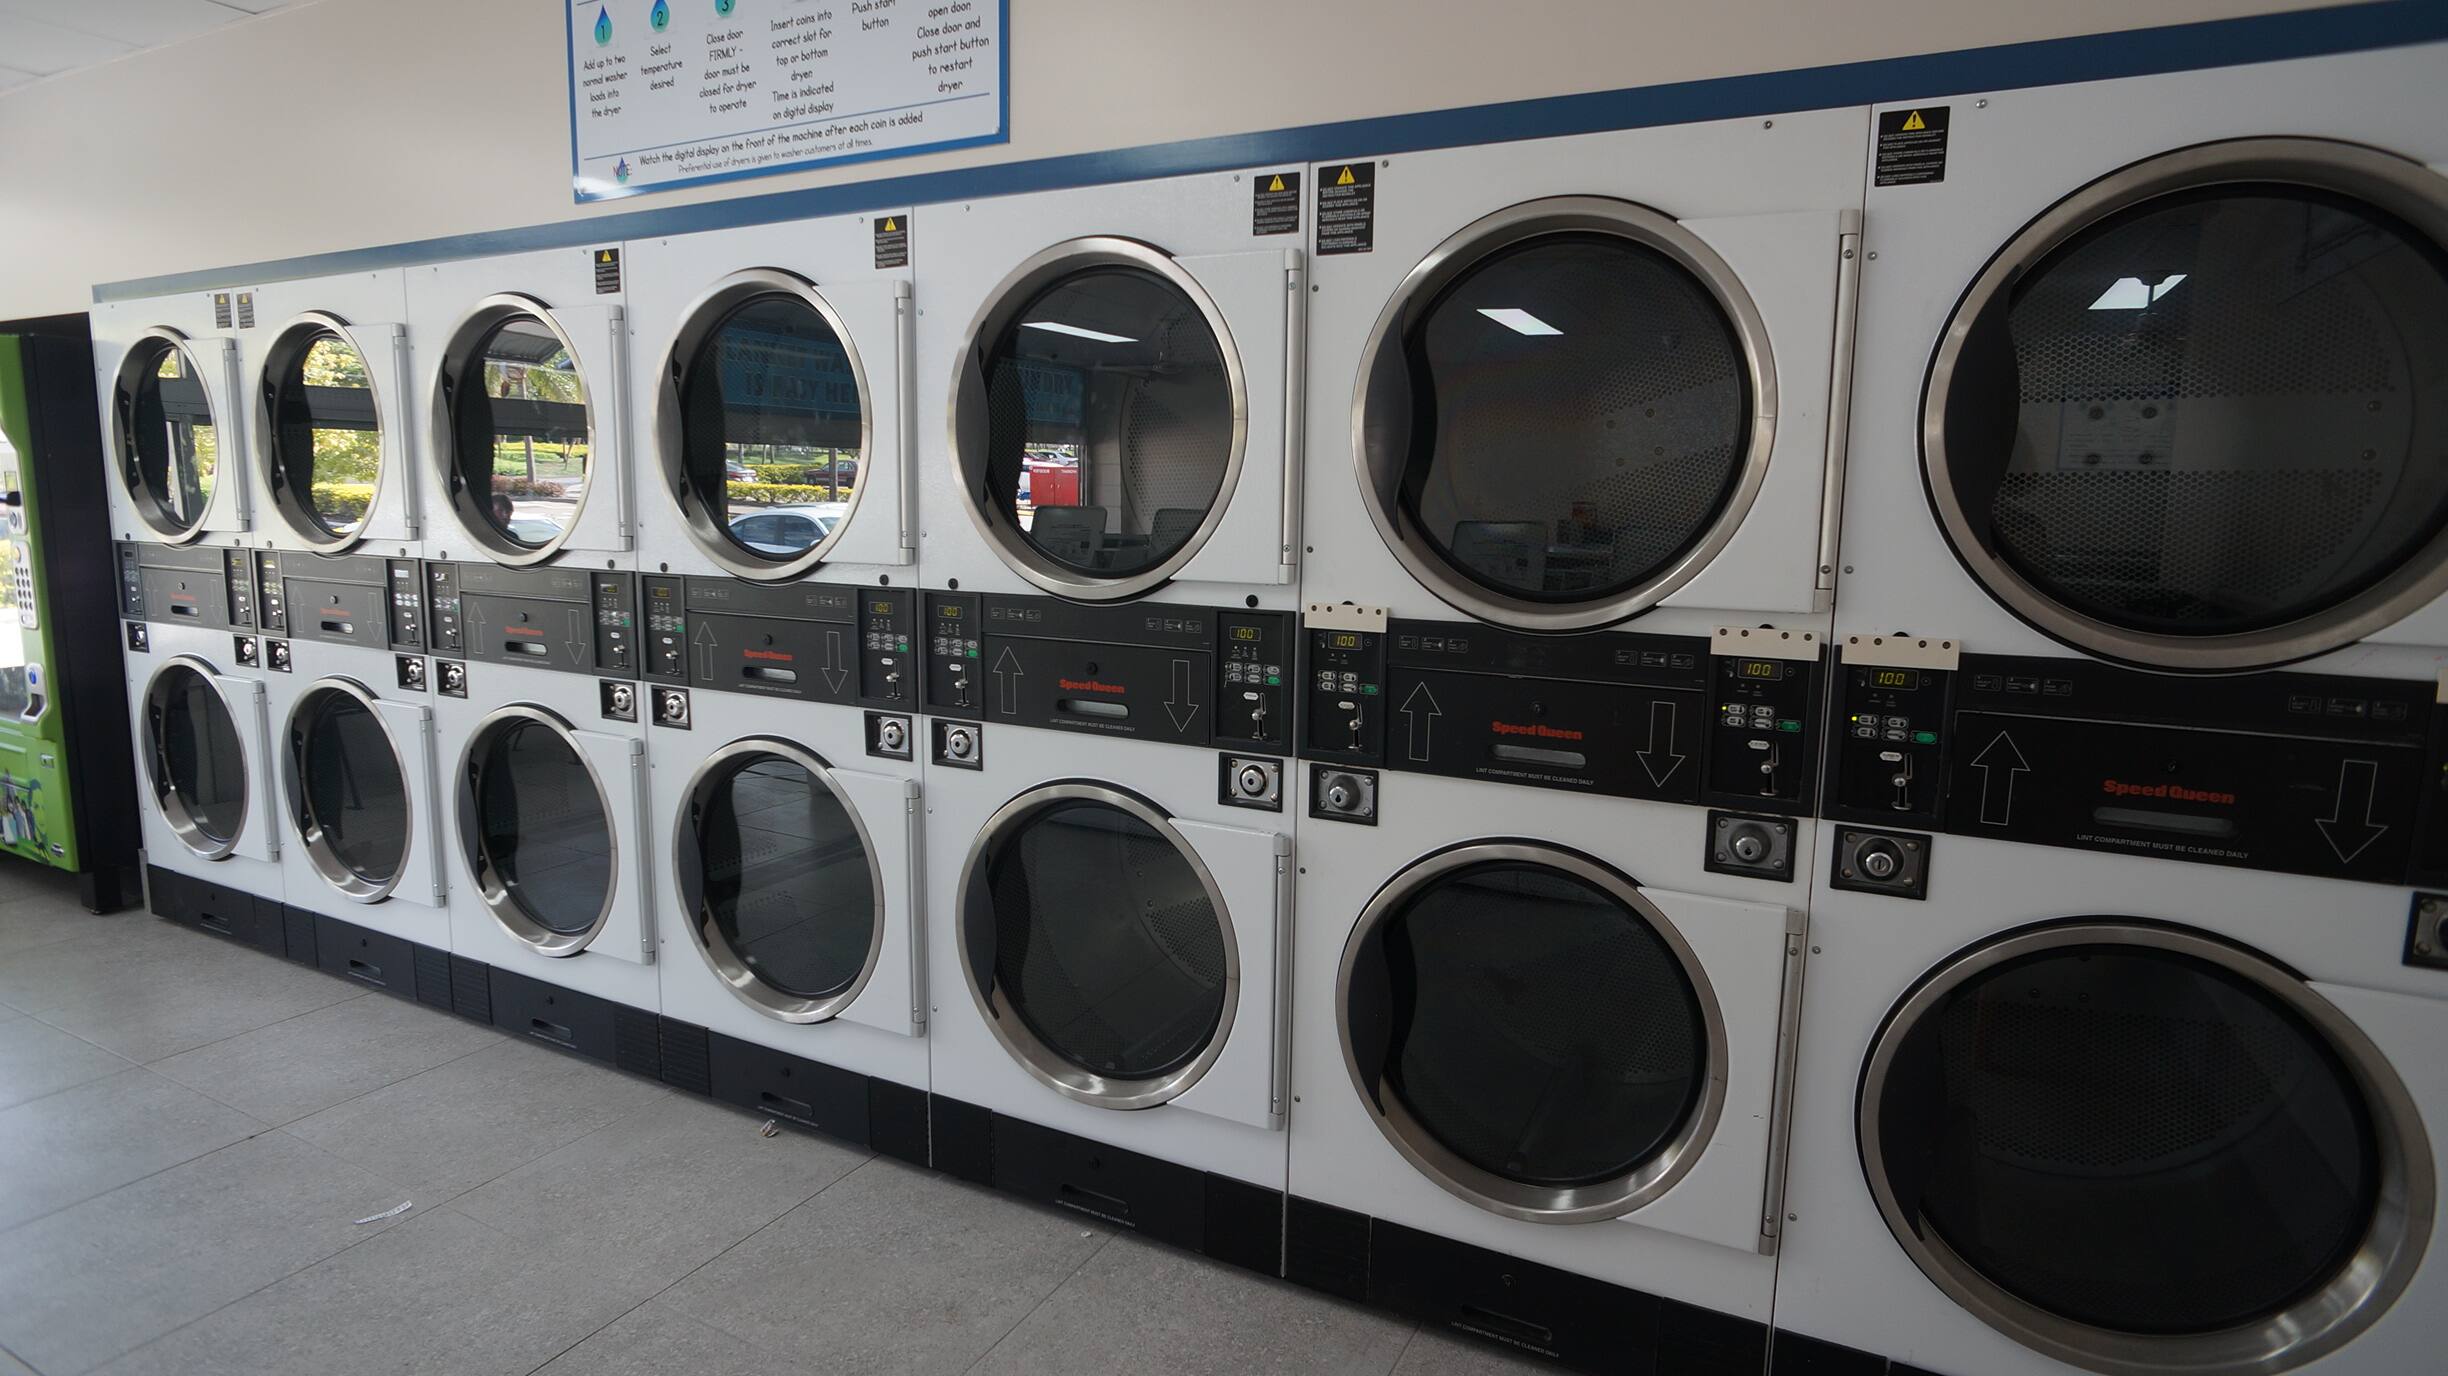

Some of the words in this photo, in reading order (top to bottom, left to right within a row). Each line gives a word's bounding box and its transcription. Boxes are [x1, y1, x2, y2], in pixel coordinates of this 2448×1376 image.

[721, 0, 729, 12] 3
[851, 0, 873, 14] Push
[874, 0, 896, 10] start
[928, 6, 949, 19] open
[657, 10, 664, 26] 2
[770, 16, 794, 32] Insert
[795, 13, 816, 26] coins
[817, 9, 832, 22] into
[861, 17, 890, 31] button
[600, 25, 605, 40] 1
[917, 26, 940, 39] Close
[942, 21, 963, 35] door
[965, 15, 981, 30] and
[706, 33, 725, 45] Close
[726, 28, 744, 41] door
[771, 33, 801, 49] correct
[803, 29, 817, 43] slot
[819, 27, 832, 40] for
[650, 42, 671, 57] Select
[709, 45, 737, 61] FIRMLY
[912, 44, 932, 62] push
[934, 40, 957, 55] start
[960, 35, 990, 51] button
[583, 59, 596, 70] Add
[596, 61, 605, 70] up
[606, 56, 613, 66] to
[614, 55, 626, 65] two
[776, 55, 789, 67] top
[790, 54, 799, 64] or
[800, 48, 828, 62] bottom
[928, 63, 937, 75] to
[940, 56, 973, 73] restart
[640, 60, 683, 77] temperature
[704, 68, 721, 81] door
[722, 63, 739, 76] must
[740, 61, 750, 73] be
[582, 74, 603, 87] normal
[605, 71, 628, 82] washer
[650, 75, 674, 91] desired
[938, 80, 963, 94] dryer
[589, 90, 606, 102] loads
[607, 88, 620, 99] into
[699, 83, 721, 98] closed
[722, 82, 735, 95] for
[736, 80, 757, 93] dryer
[772, 90, 790, 103] Time
[791, 90, 798, 99] is
[799, 80, 834, 98] indicated
[592, 108, 602, 118] the
[603, 106, 621, 117] dryer
[709, 103, 717, 114] to
[718, 98, 747, 114] operate
[772, 111, 782, 120] on
[783, 103, 806, 120] digital
[807, 99, 834, 115] display
[639, 153, 660, 167] Watch
[662, 151, 673, 162] the
[674, 147, 695, 162] digital
[696, 144, 720, 157] display
[721, 145, 730, 153] on
[731, 140, 743, 150] the
[745, 137, 765, 149] front
[766, 134, 776, 146] of
[777, 132, 790, 144] the
[792, 128, 822, 142] machine
[825, 124, 847, 137] after
[849, 119, 869, 133] each
[870, 119, 887, 130] coin
[889, 117, 896, 127] is
[898, 111, 923, 125] added
[678, 161, 712, 174] Preferential
[712, 161, 722, 169] use
[723, 157, 730, 167] of
[730, 156, 750, 167] dryers
[757, 153, 772, 164] given
[773, 150, 779, 160] to
[781, 147, 804, 158] washer
[804, 144, 836, 156] customers
[837, 141, 845, 150] at
[1236, 628, 1254, 639] 100
[1336, 635, 1355, 647] 100
[1747, 663, 1771, 676] 100
[1879, 672, 1905, 686] 100
[1491, 720, 1537, 735] Speed
[1537, 724, 1584, 740] Queen
[1488, 768, 1528, 778] COMPARTMENT
[1552, 775, 1578, 784] CLEANED
[1578, 778, 1594, 786] DAILY
[2103, 779, 2167, 797] Speed
[2168, 785, 2235, 804] Queen
[2076, 833, 2093, 841] LINT
[2093, 835, 2151, 849] COMPARTMENT
[2152, 842, 2174, 851] MUST
[2175, 844, 2187, 853] BE
[2187, 845, 2225, 857] CLEANED
[2226, 850, 2249, 860] DAILY
